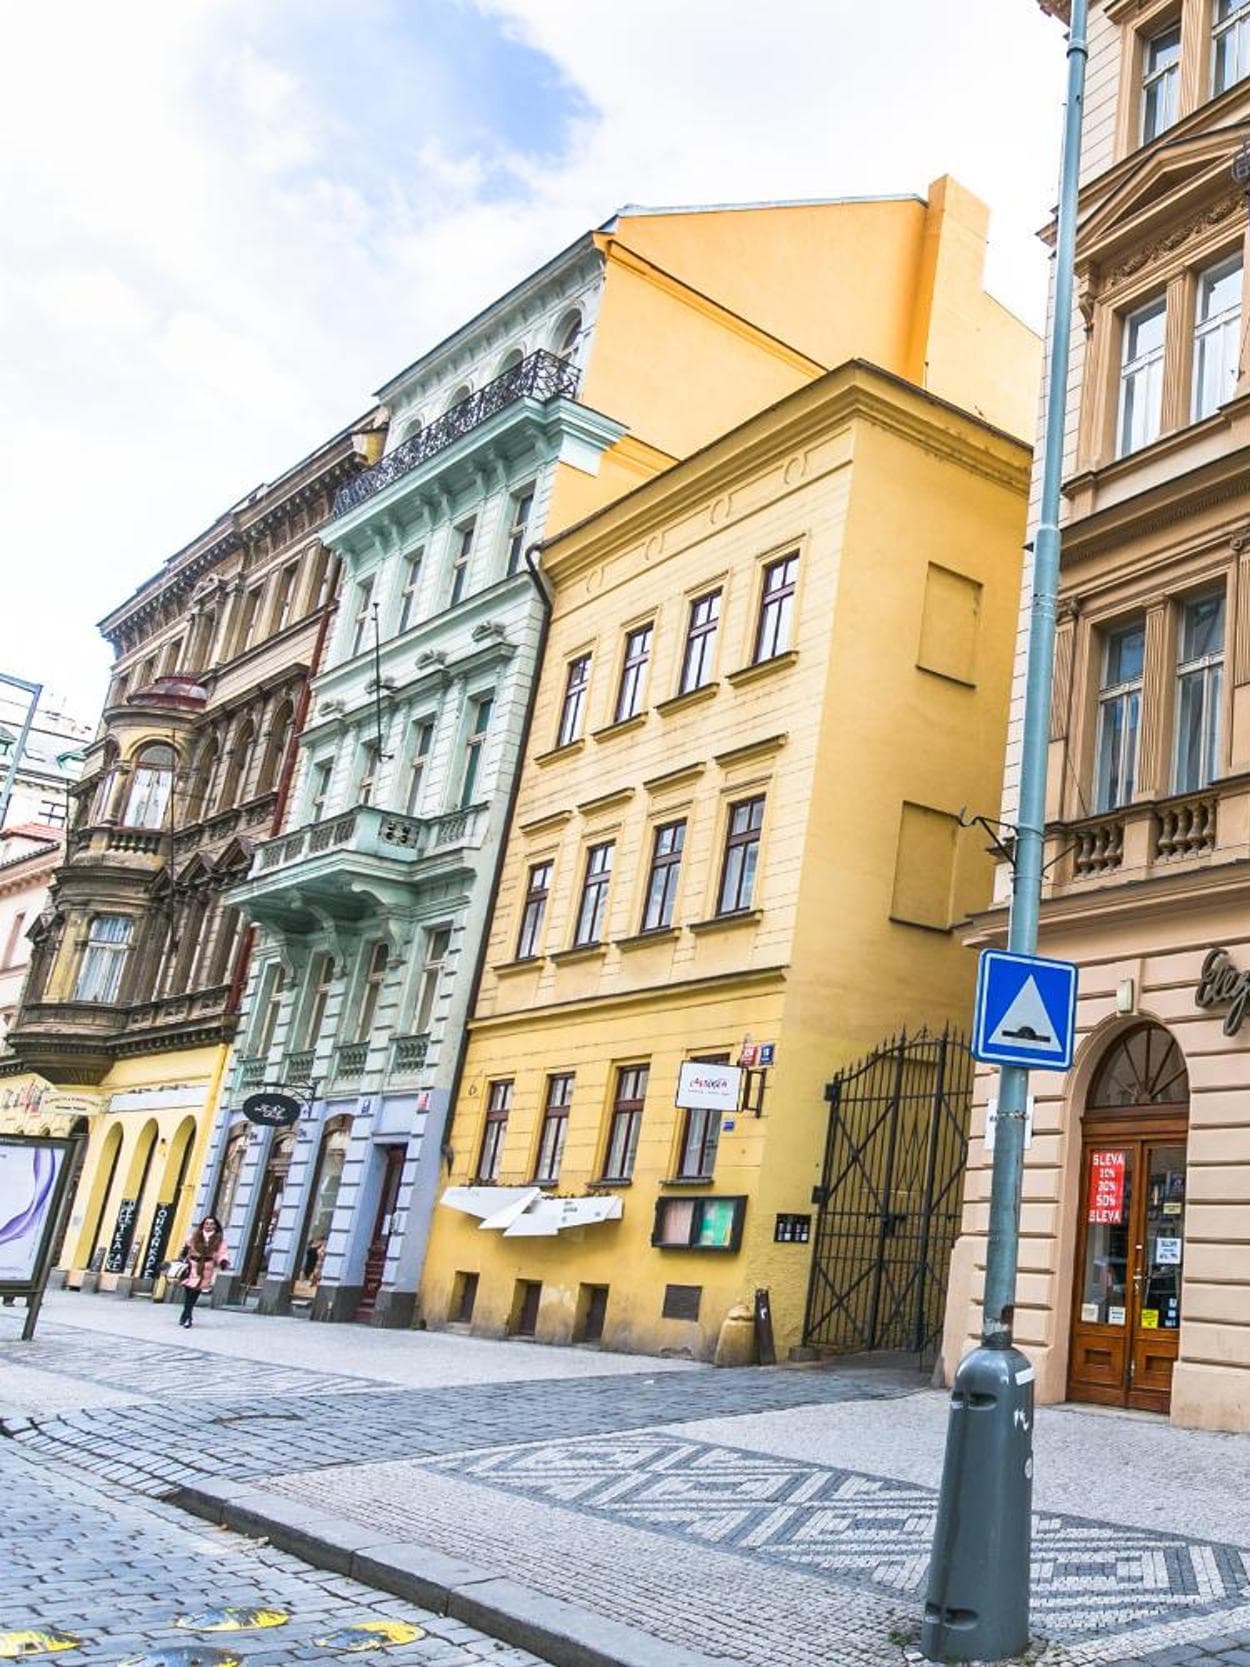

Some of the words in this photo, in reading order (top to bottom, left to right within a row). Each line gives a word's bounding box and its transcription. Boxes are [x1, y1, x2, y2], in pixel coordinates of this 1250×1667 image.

[1092, 1152, 1125, 1166] SLEVA
[1096, 1194, 1116, 1206] 50%
[1088, 1209, 1121, 1224] SLEVA
